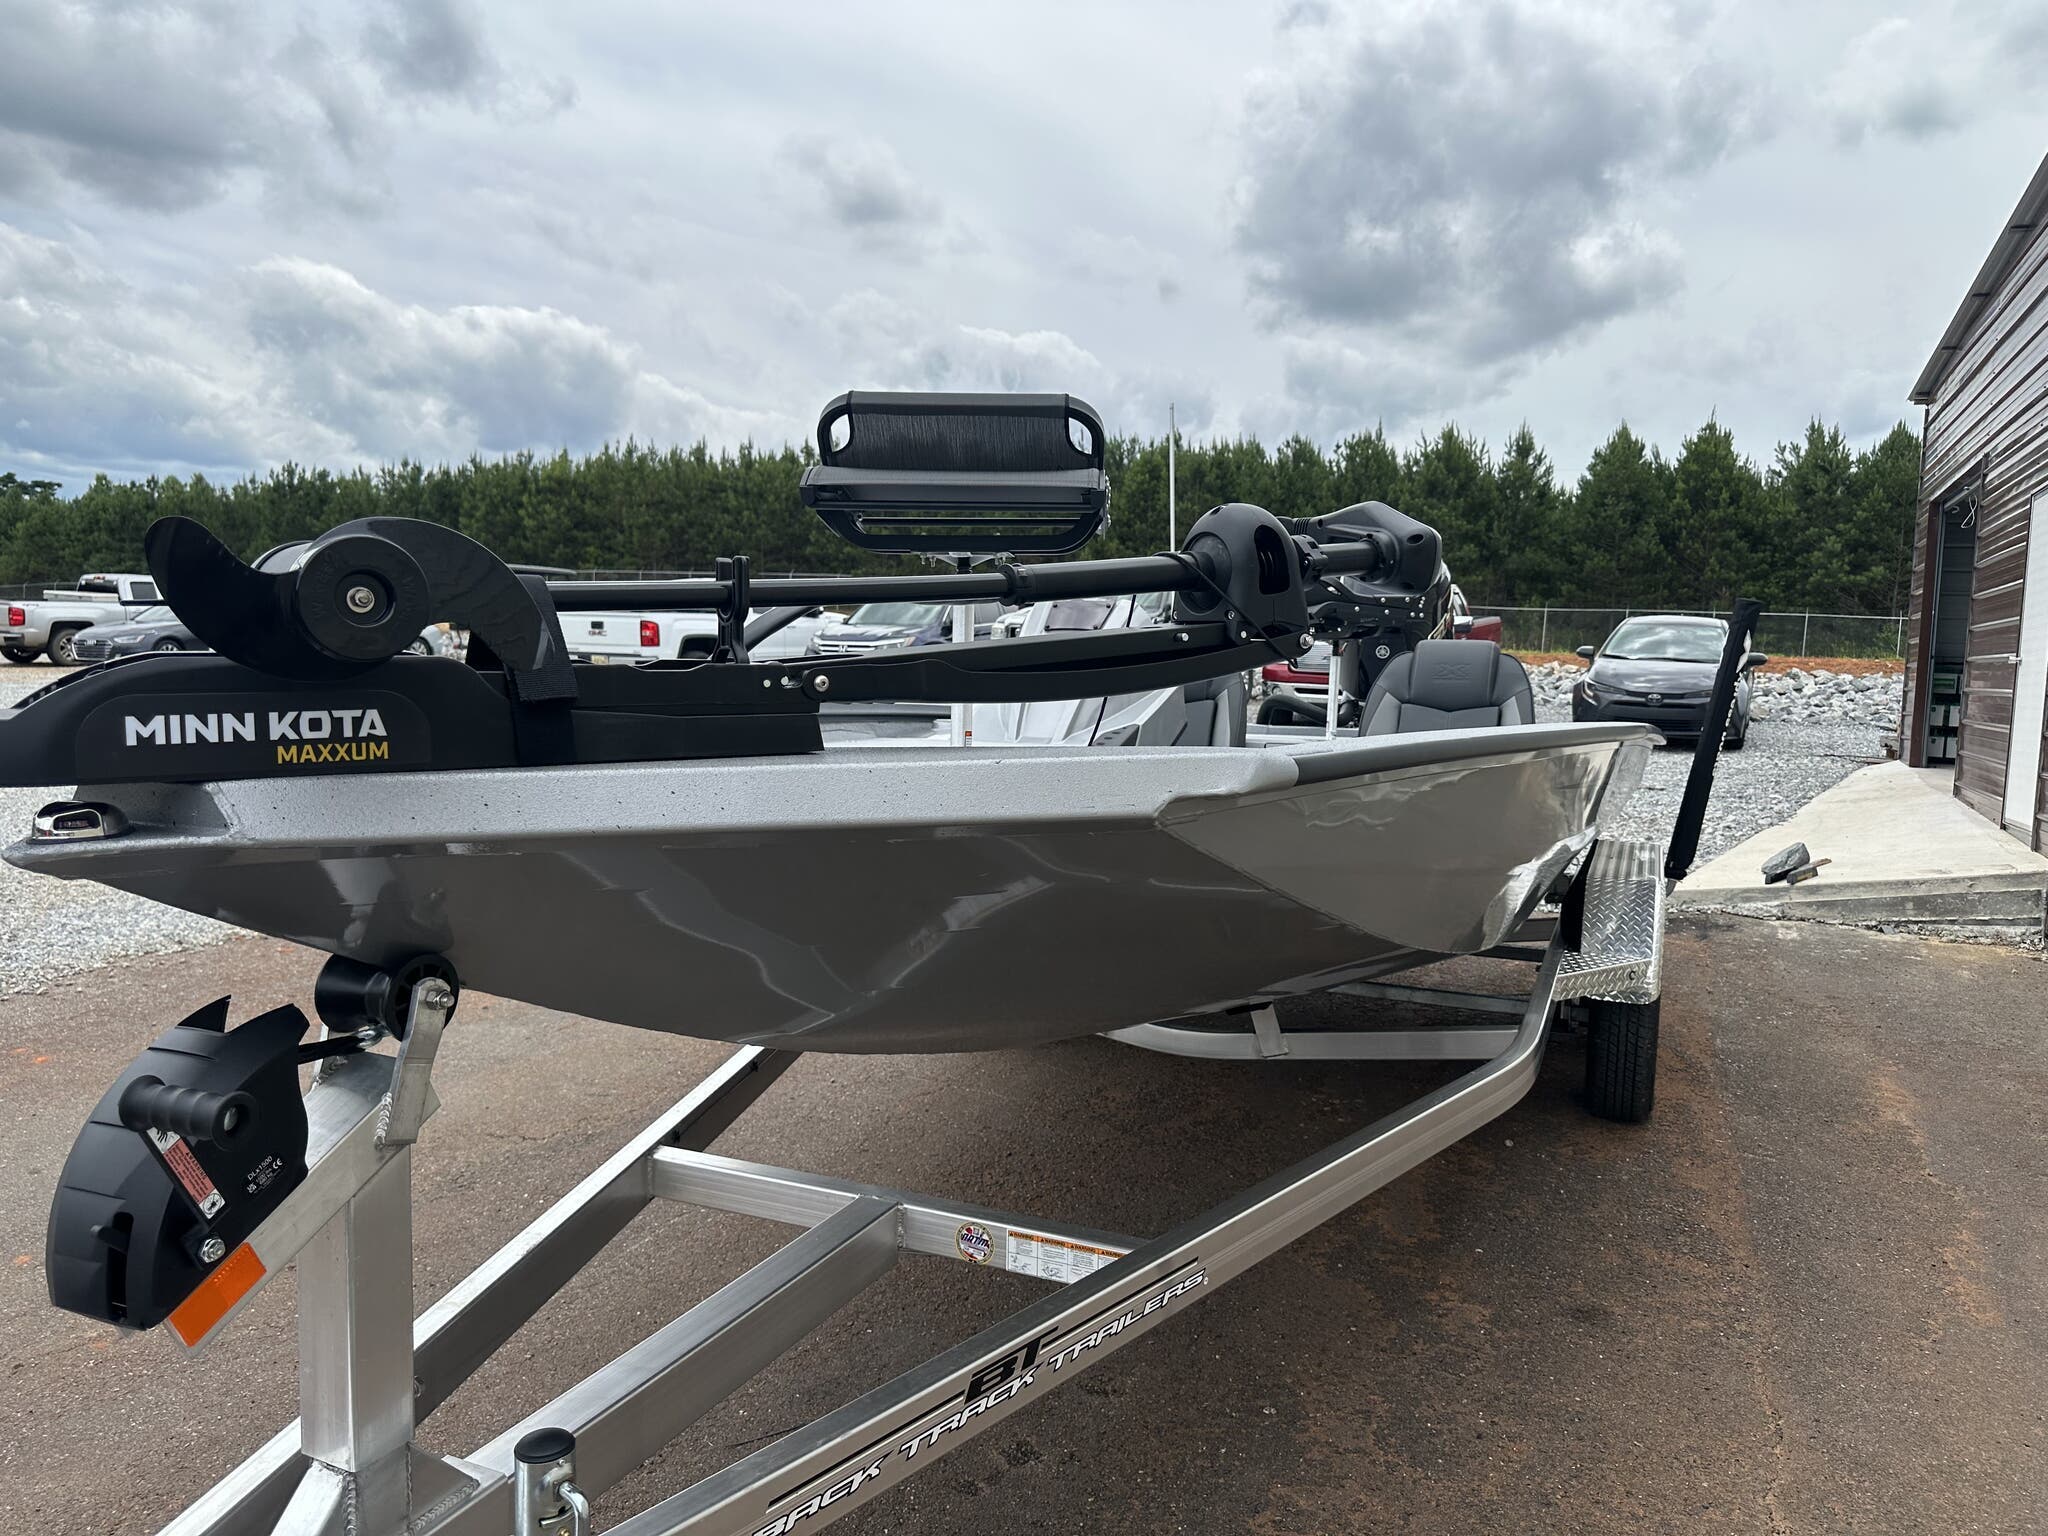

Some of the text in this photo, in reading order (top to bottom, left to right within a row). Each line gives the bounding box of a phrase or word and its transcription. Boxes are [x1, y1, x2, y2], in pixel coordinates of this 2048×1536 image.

[124, 708, 388, 746] MINN KOTA
[276, 741, 389, 764] MAXXUM
[964, 1326, 1059, 1405] BT
[752, 1450, 895, 1536] BACK
[898, 1361, 1043, 1462] TRACK
